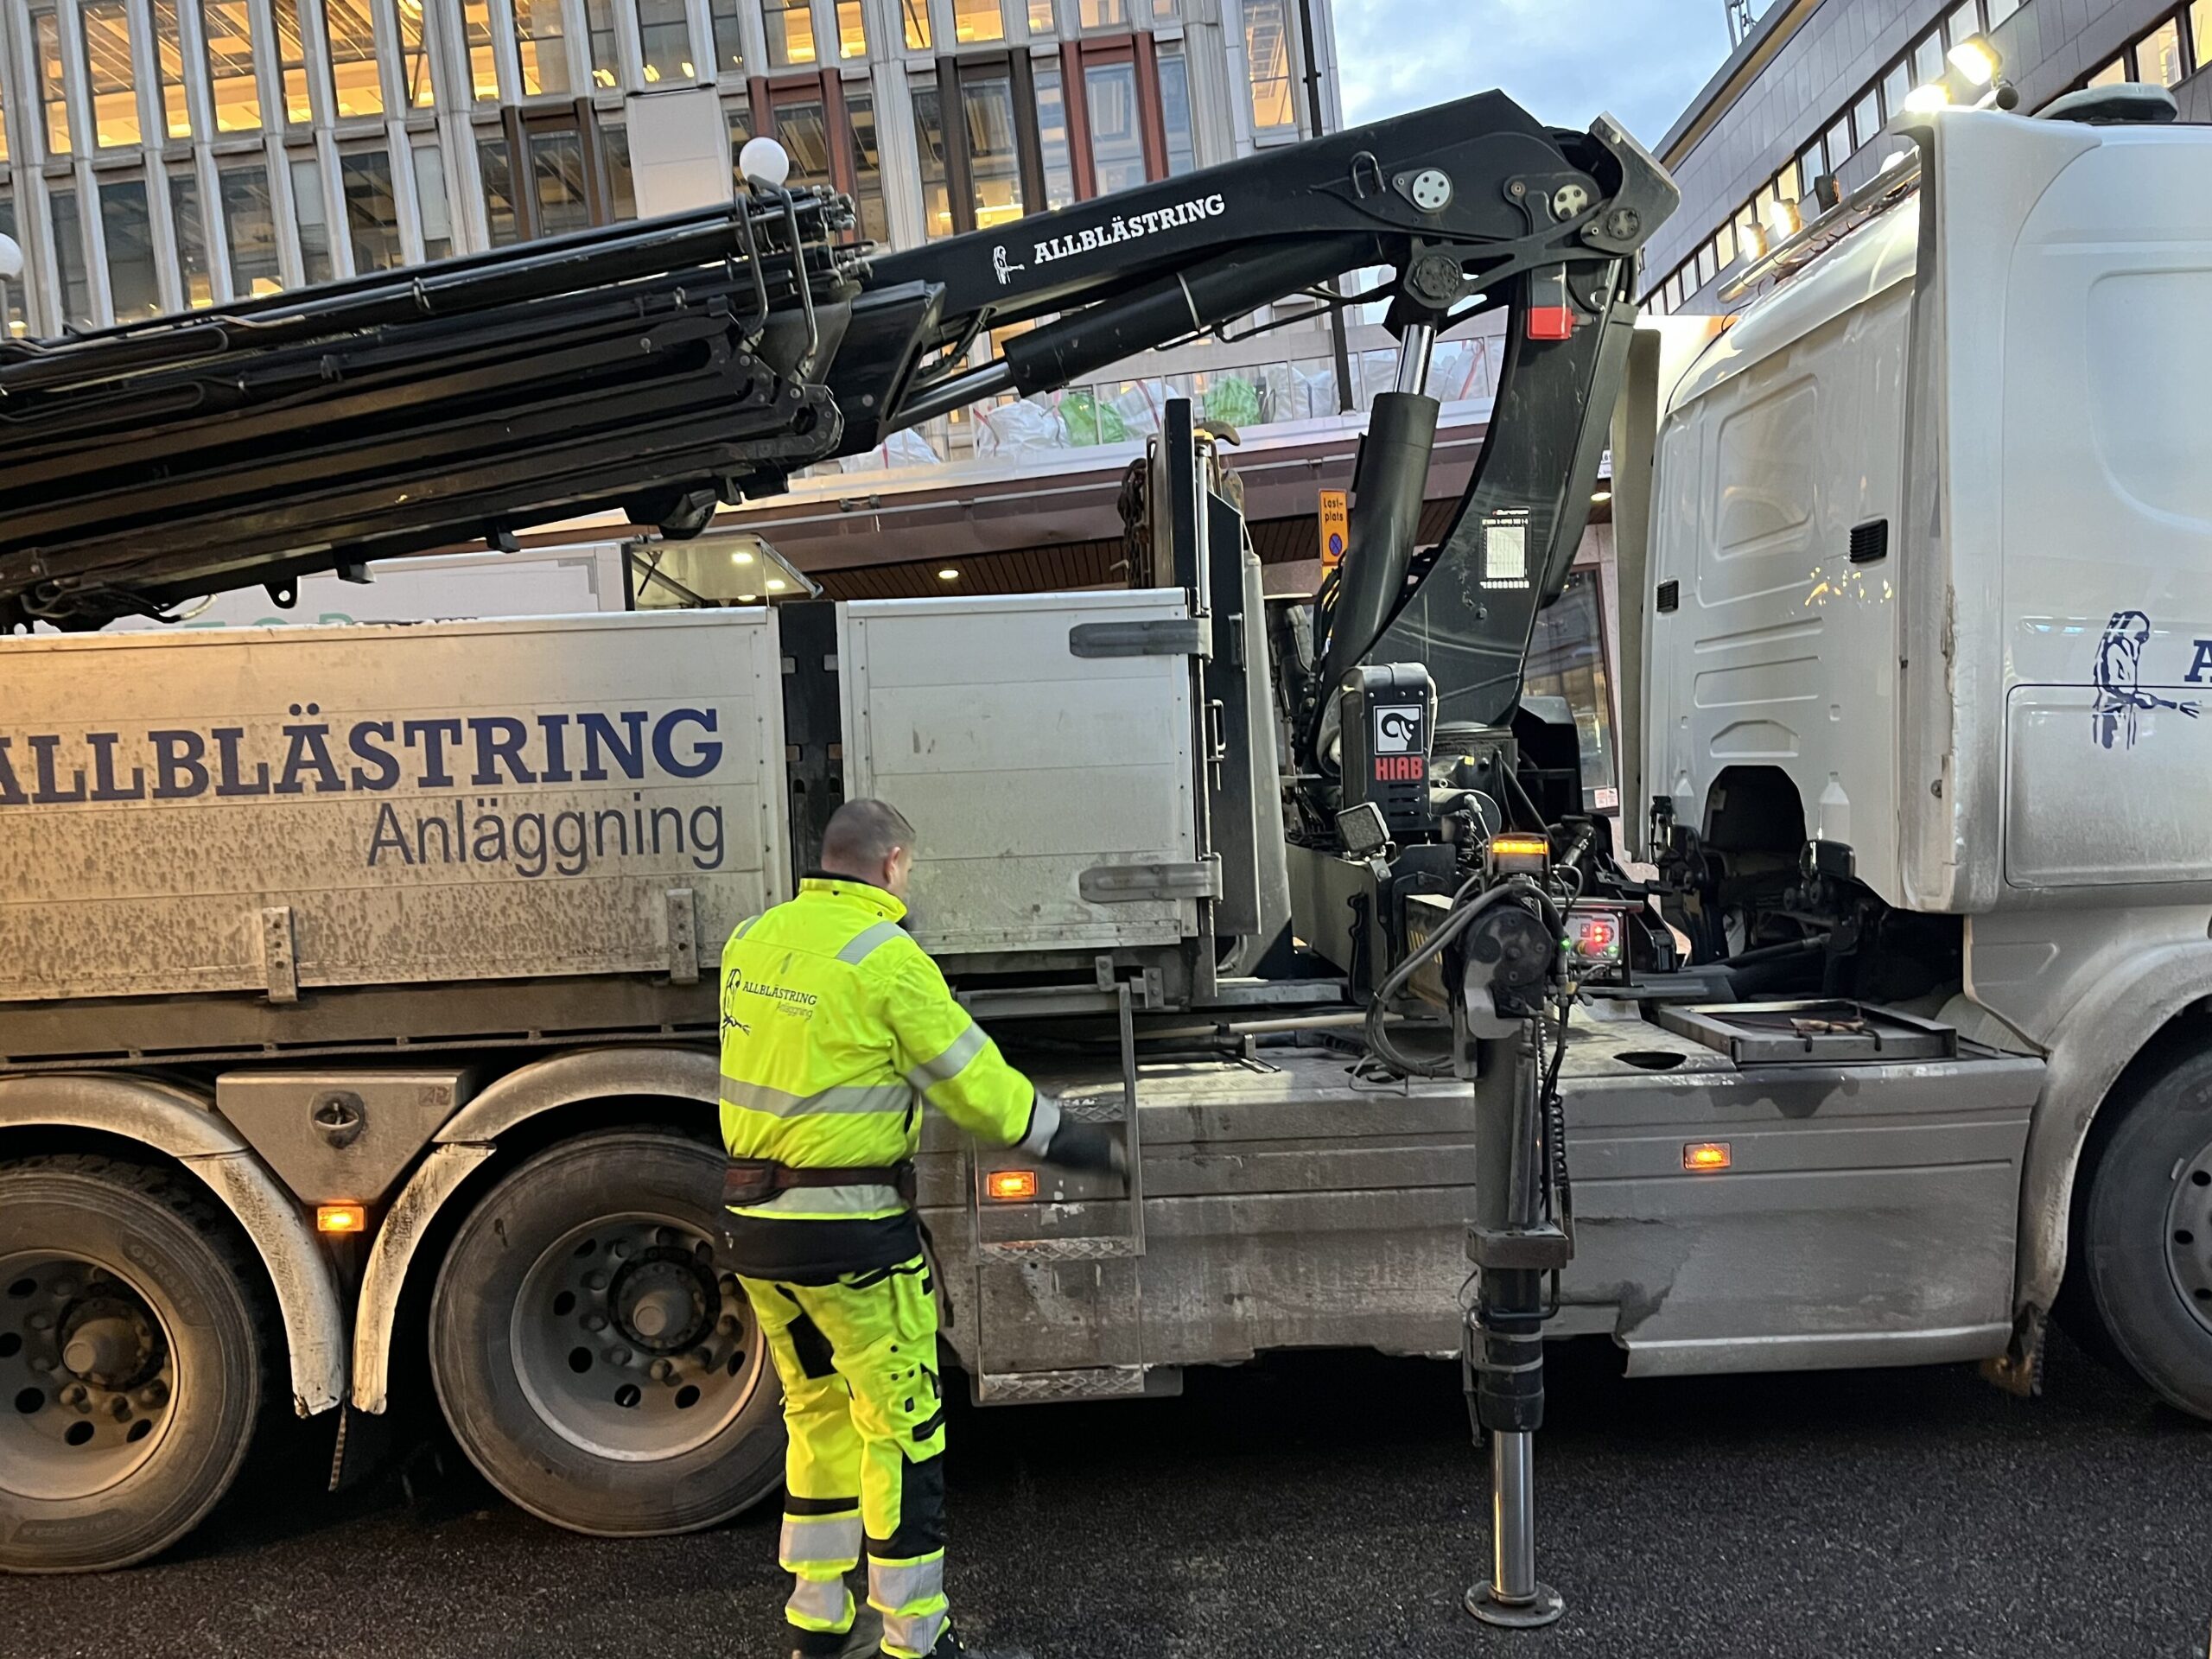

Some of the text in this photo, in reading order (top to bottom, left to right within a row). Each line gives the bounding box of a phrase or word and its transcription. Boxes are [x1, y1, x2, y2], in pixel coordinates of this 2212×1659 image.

[1034, 194, 1226, 264] ALLBLÄSTRING
[1325, 511, 1344, 523] plats
[1375, 756, 1423, 781] HIAB
[367, 792, 725, 878] Anläggning
[742, 982, 817, 1006] ALLBLÄSTRING
